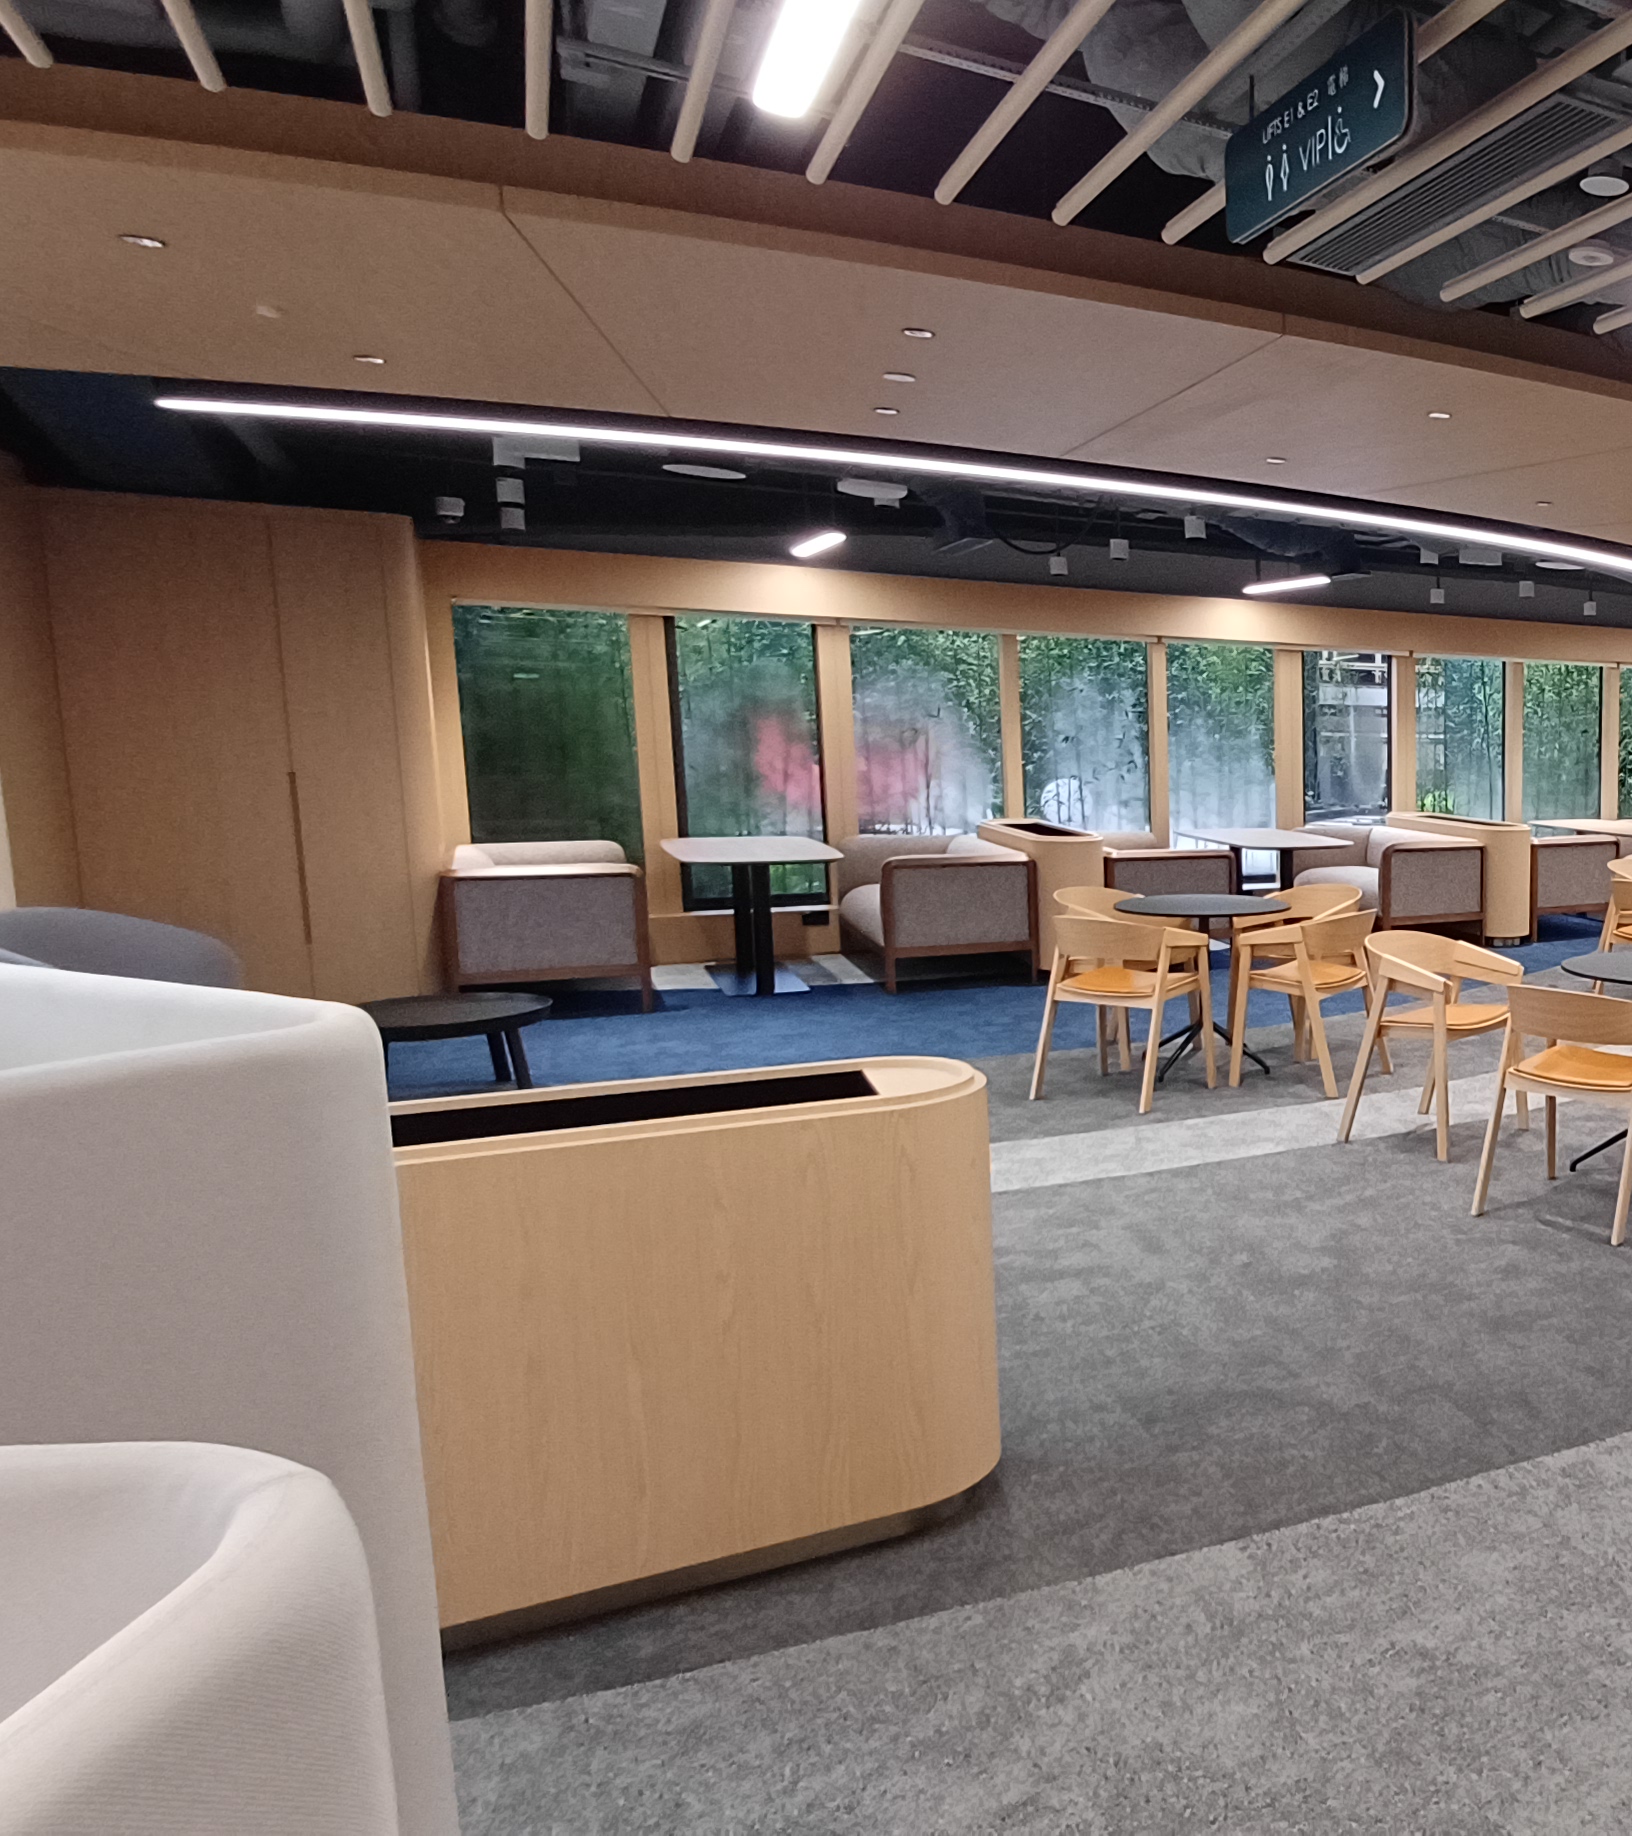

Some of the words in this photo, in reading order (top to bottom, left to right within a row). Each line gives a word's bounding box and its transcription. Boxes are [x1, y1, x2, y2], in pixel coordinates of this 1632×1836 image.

[1262, 116, 1282, 144] LIFTS
[1297, 101, 1306, 118] &
[1307, 89, 1319, 111] E2
[1299, 129, 1326, 171] VIP
